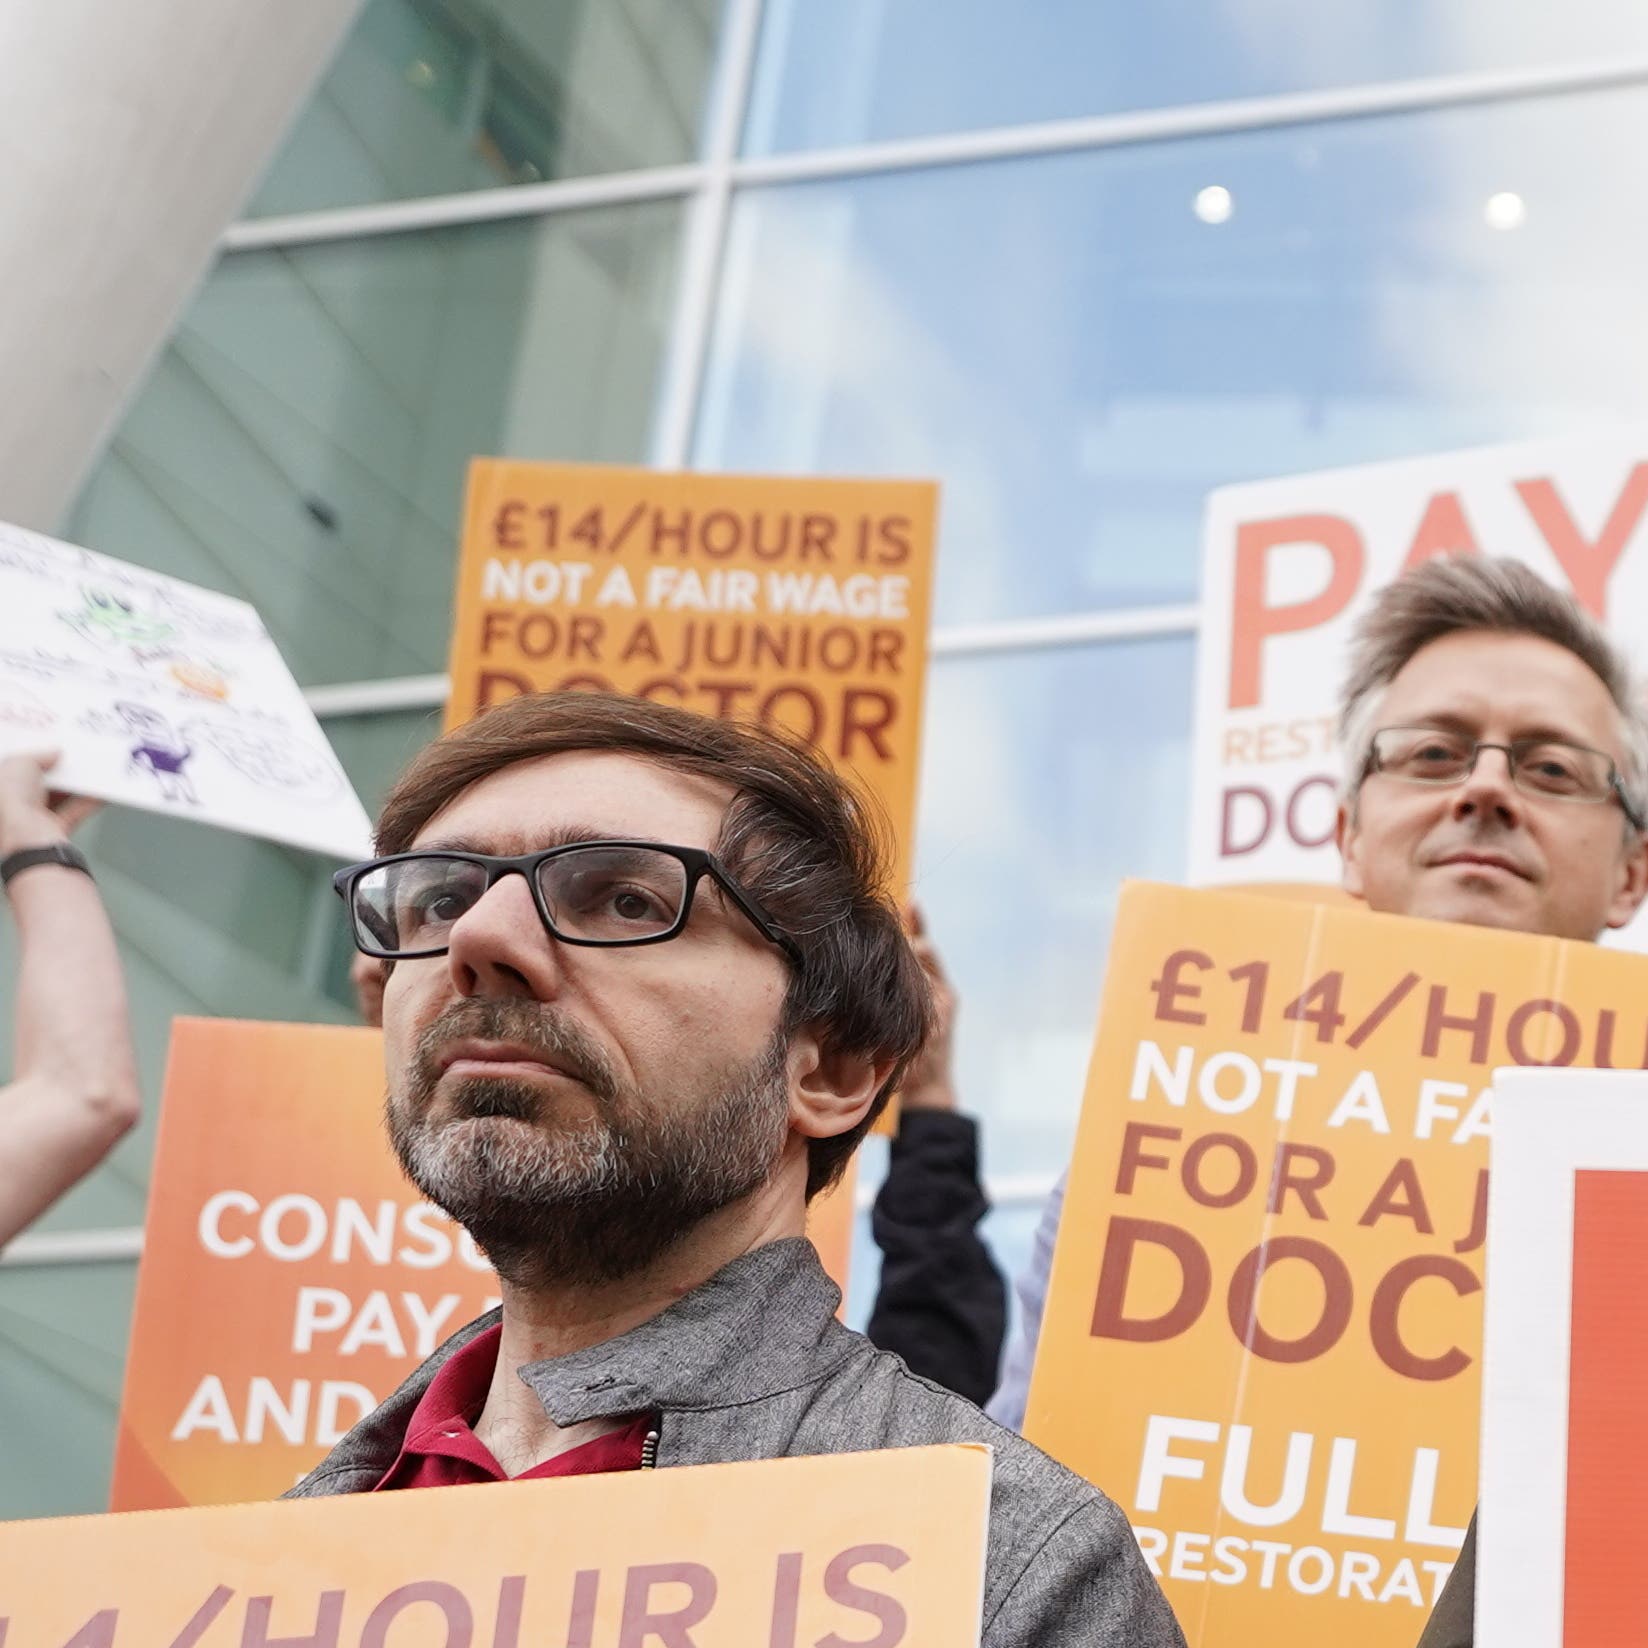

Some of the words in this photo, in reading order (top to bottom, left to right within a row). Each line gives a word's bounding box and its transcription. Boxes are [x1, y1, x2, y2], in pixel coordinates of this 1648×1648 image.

[493, 500, 838, 564] £14/HOUR
[857, 513, 913, 567] IS
[483, 558, 592, 605] NOT
[597, 565, 636, 607] A
[646, 565, 759, 613] FAIR
[767, 571, 911, 620] WAGE
[480, 609, 606, 662] FOR
[622, 618, 662, 664] A
[676, 619, 906, 675] JUNIOR
[1130, 1040, 1319, 1120] NOT
[1329, 1071, 1391, 1134] A
[1114, 1121, 1338, 1222] FOR
[1358, 1158, 1434, 1234] A
[292, 1286, 461, 1359] PAY
[1090, 1215, 1482, 1382] DOC
[170, 1374, 380, 1447] AND
[1135, 1414, 1467, 1549] FULL
